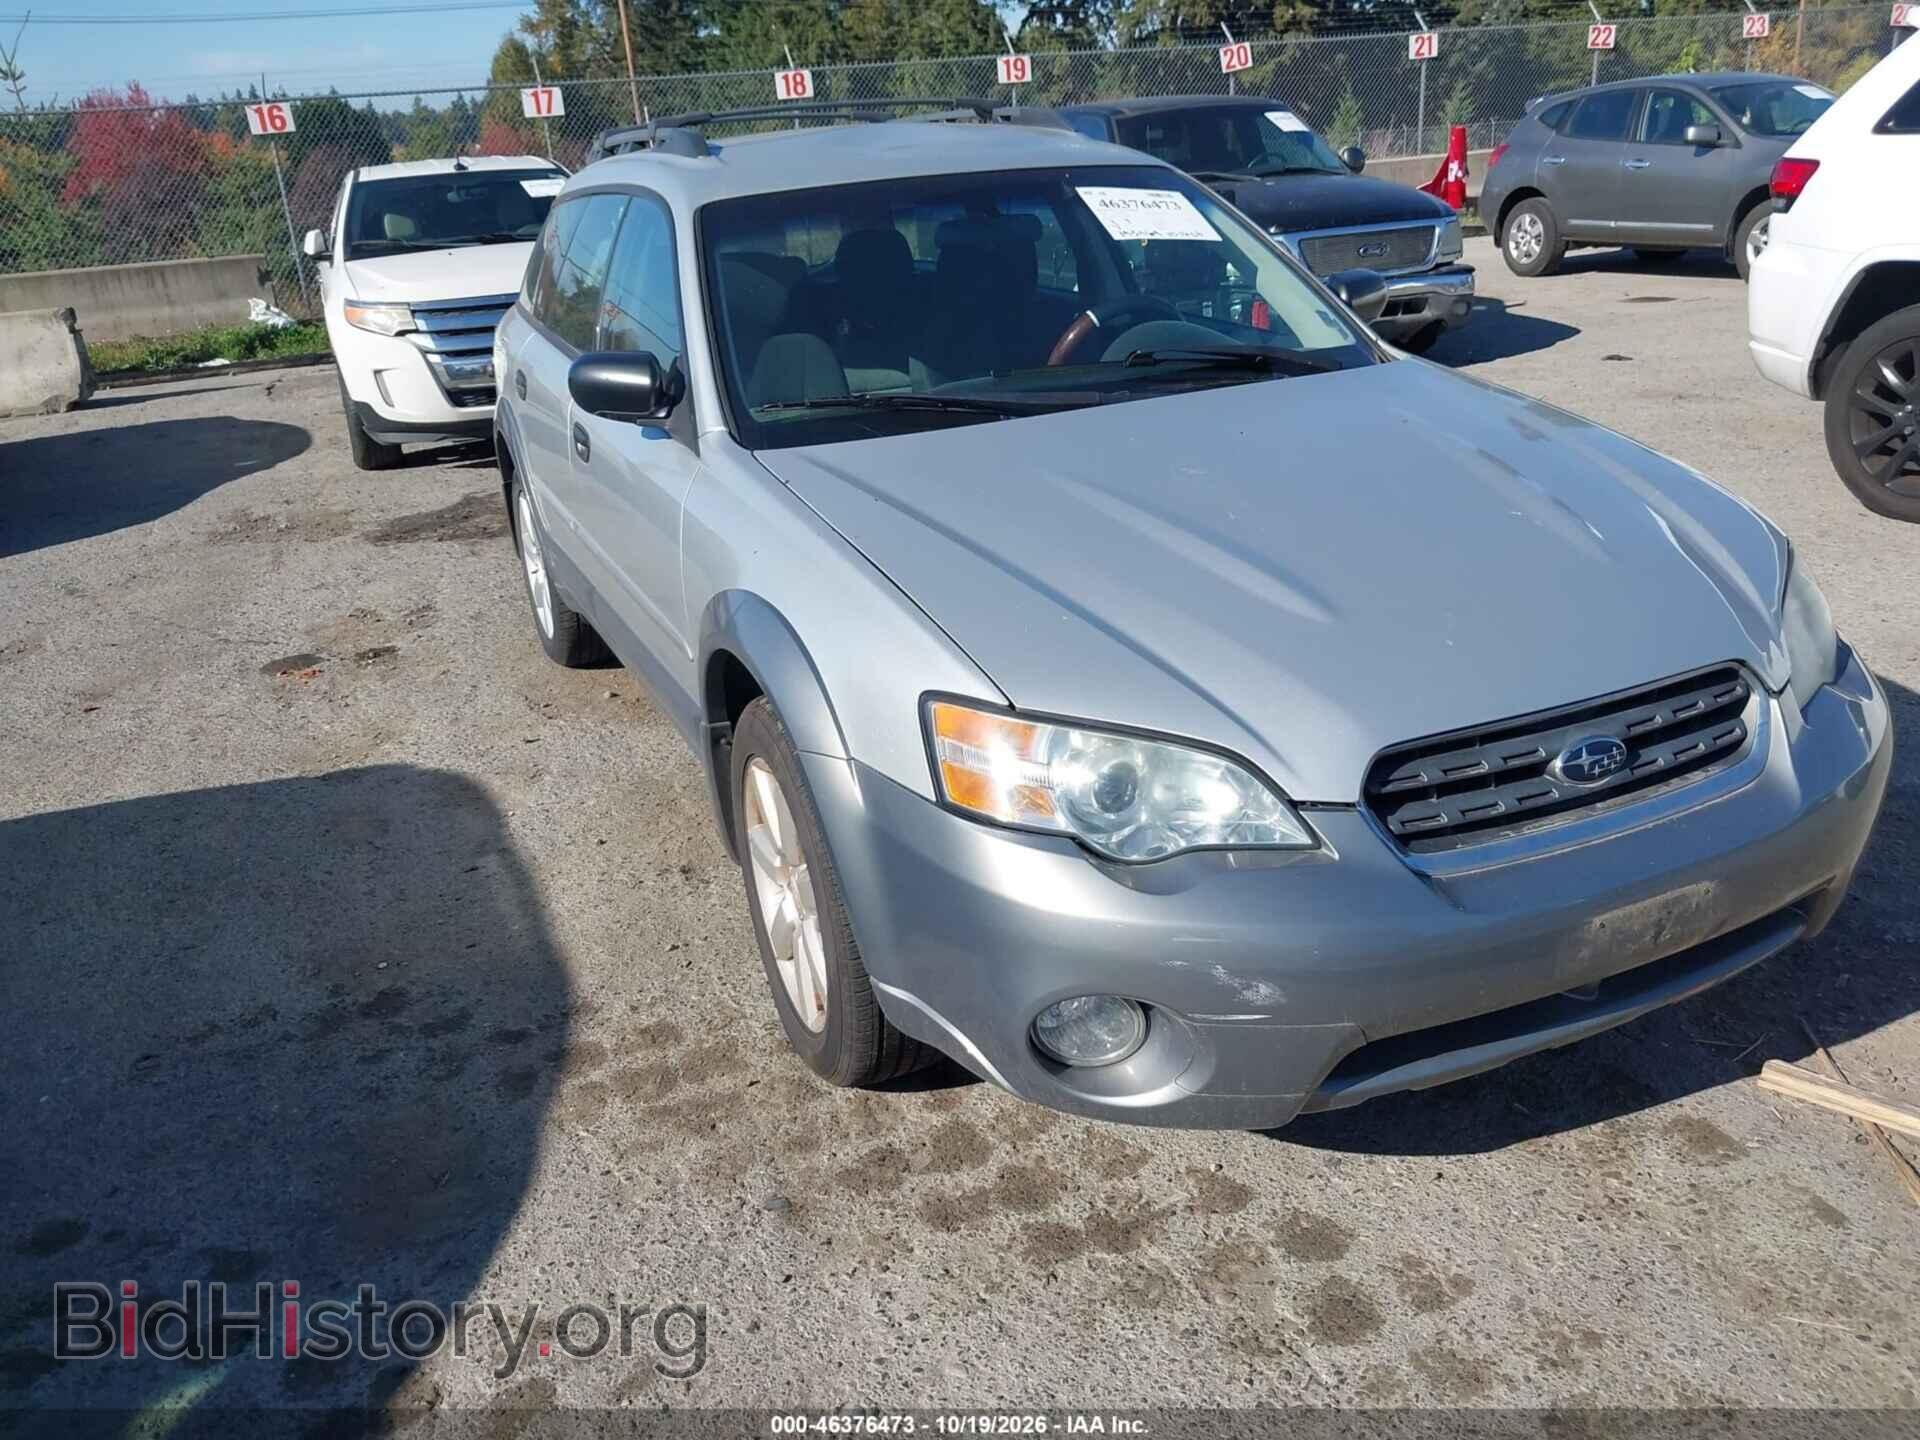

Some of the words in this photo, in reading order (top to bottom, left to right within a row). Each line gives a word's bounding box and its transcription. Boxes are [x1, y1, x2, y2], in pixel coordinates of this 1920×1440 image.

[1590, 26, 1612, 47] 22
[1745, 15, 1766, 36] 23
[1223, 45, 1249, 70] 20
[1415, 35, 1432, 57] 21
[1002, 57, 1026, 81] 19
[782, 72, 806, 97] 18
[530, 89, 553, 115] 17
[255, 104, 287, 132] 16
[1099, 199, 1182, 210] 46376473
